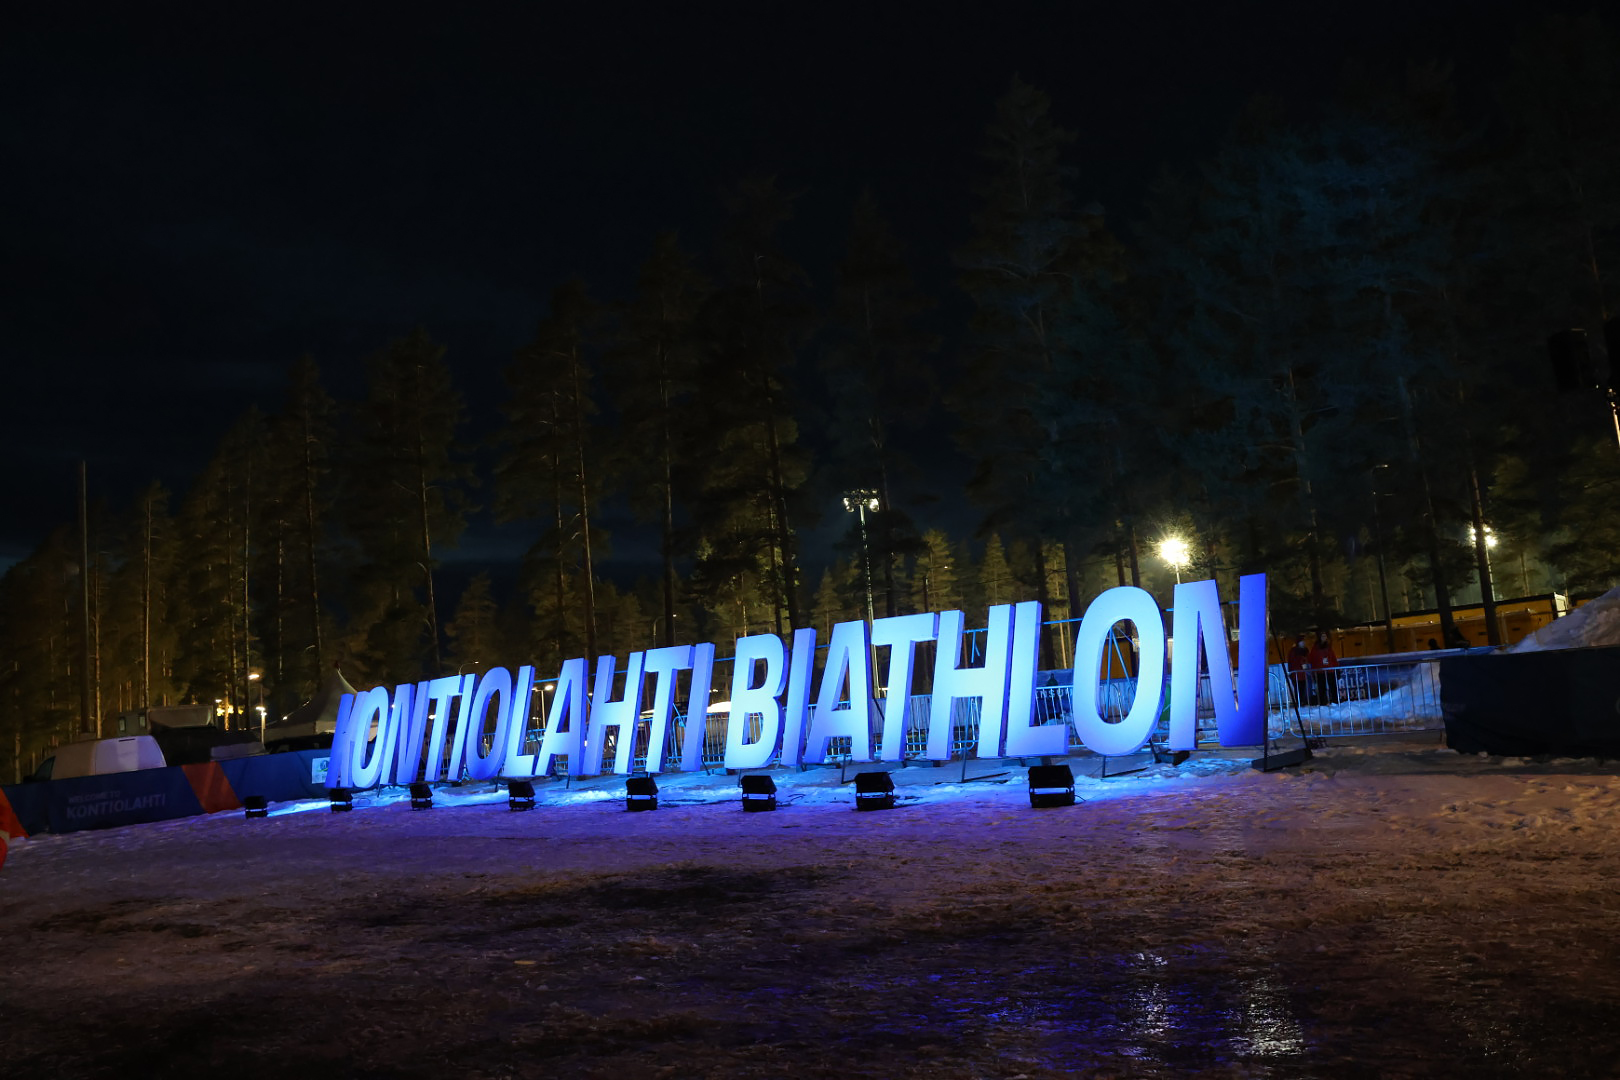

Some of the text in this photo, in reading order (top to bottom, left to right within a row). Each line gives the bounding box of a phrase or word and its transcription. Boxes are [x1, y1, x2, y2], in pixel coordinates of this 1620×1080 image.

[324, 573, 1267, 788] KONTIOLAHTI BIATHLON
[66, 793, 166, 819] KONTIOLAHTI
[68, 790, 121, 804] WELCOME TO
